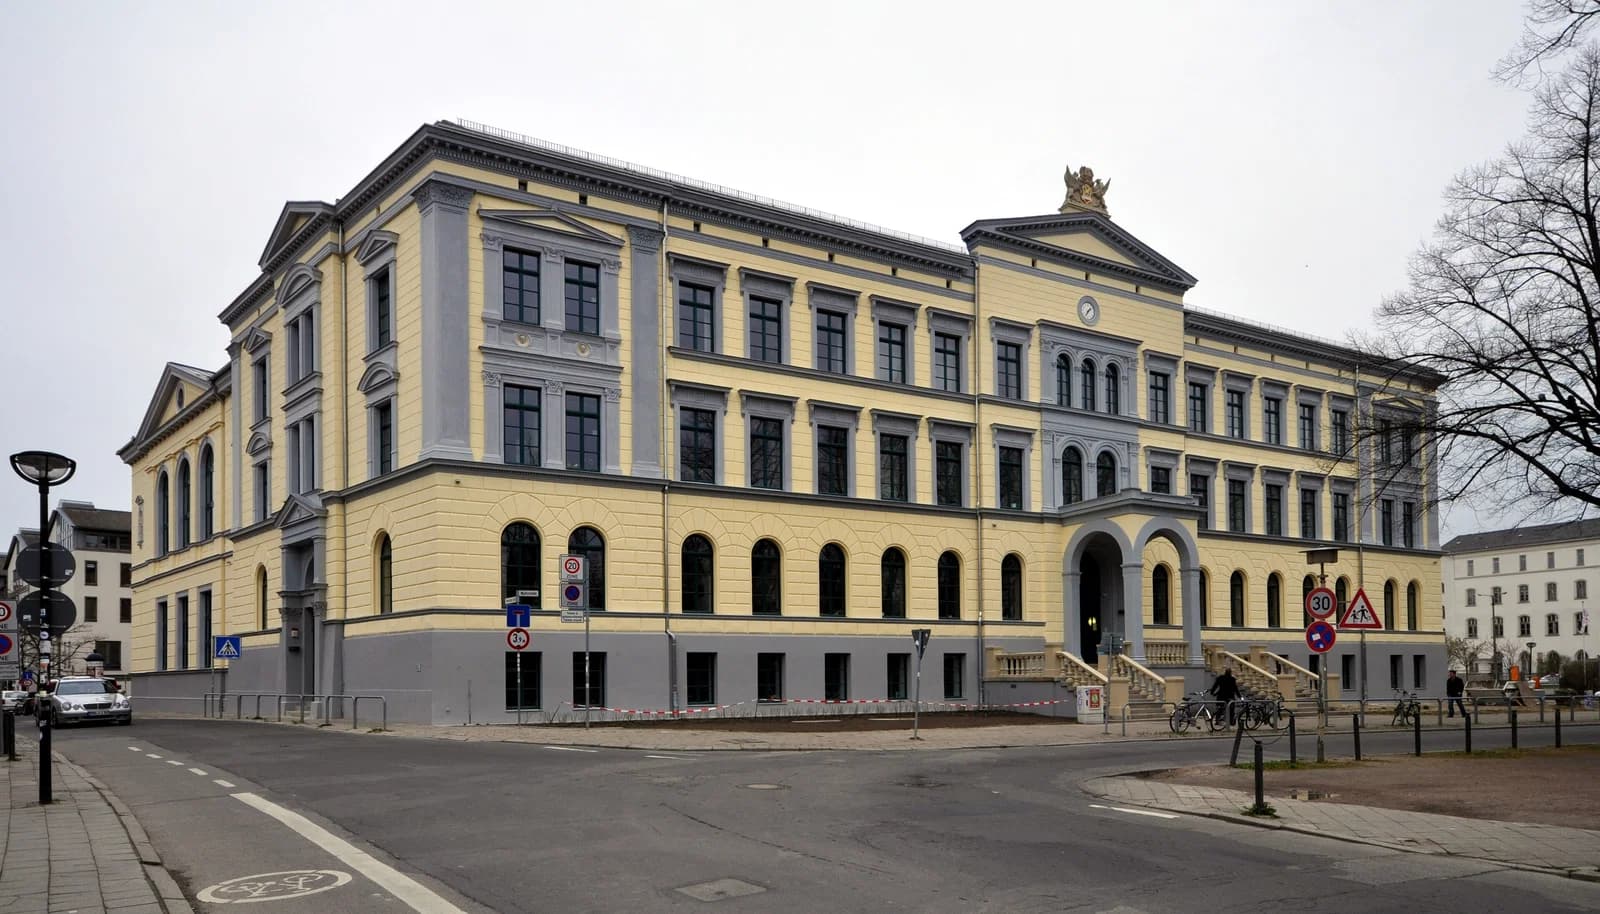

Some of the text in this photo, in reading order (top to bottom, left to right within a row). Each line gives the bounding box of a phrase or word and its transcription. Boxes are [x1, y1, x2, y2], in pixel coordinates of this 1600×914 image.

[568, 562, 577, 570] 20
[1313, 596, 1330, 611] 30
[0, 607, 6, 616] 0
